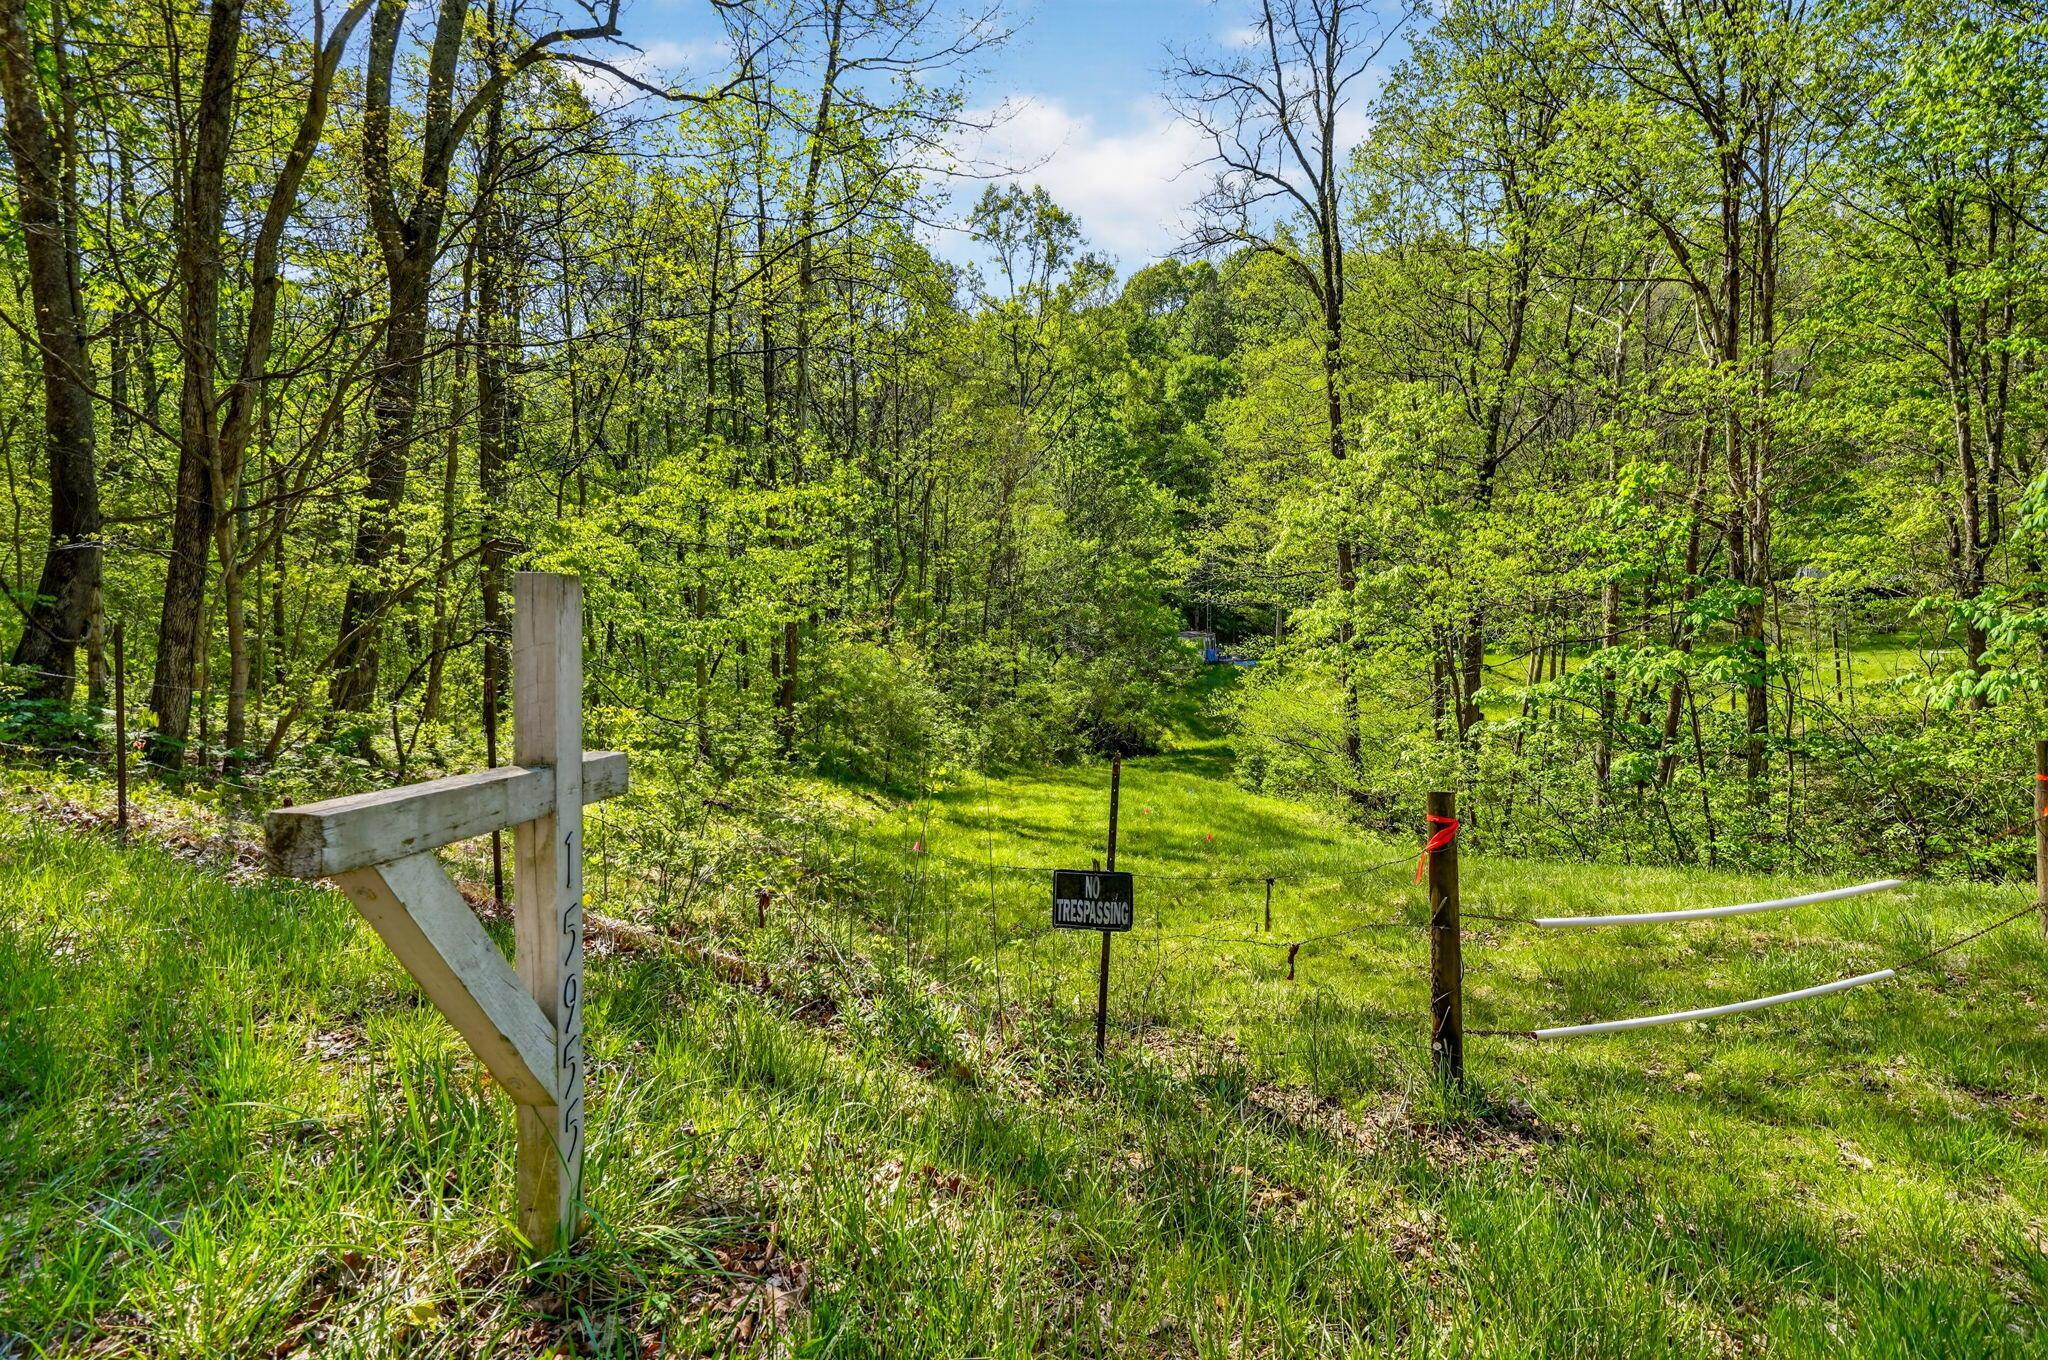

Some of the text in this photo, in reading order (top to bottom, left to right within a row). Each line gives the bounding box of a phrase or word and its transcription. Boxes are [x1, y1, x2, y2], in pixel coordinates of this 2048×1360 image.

[1085, 875, 1100, 899] NO
[1056, 898, 1129, 925] TRESPASSING
[563, 831, 579, 1163] 15955
